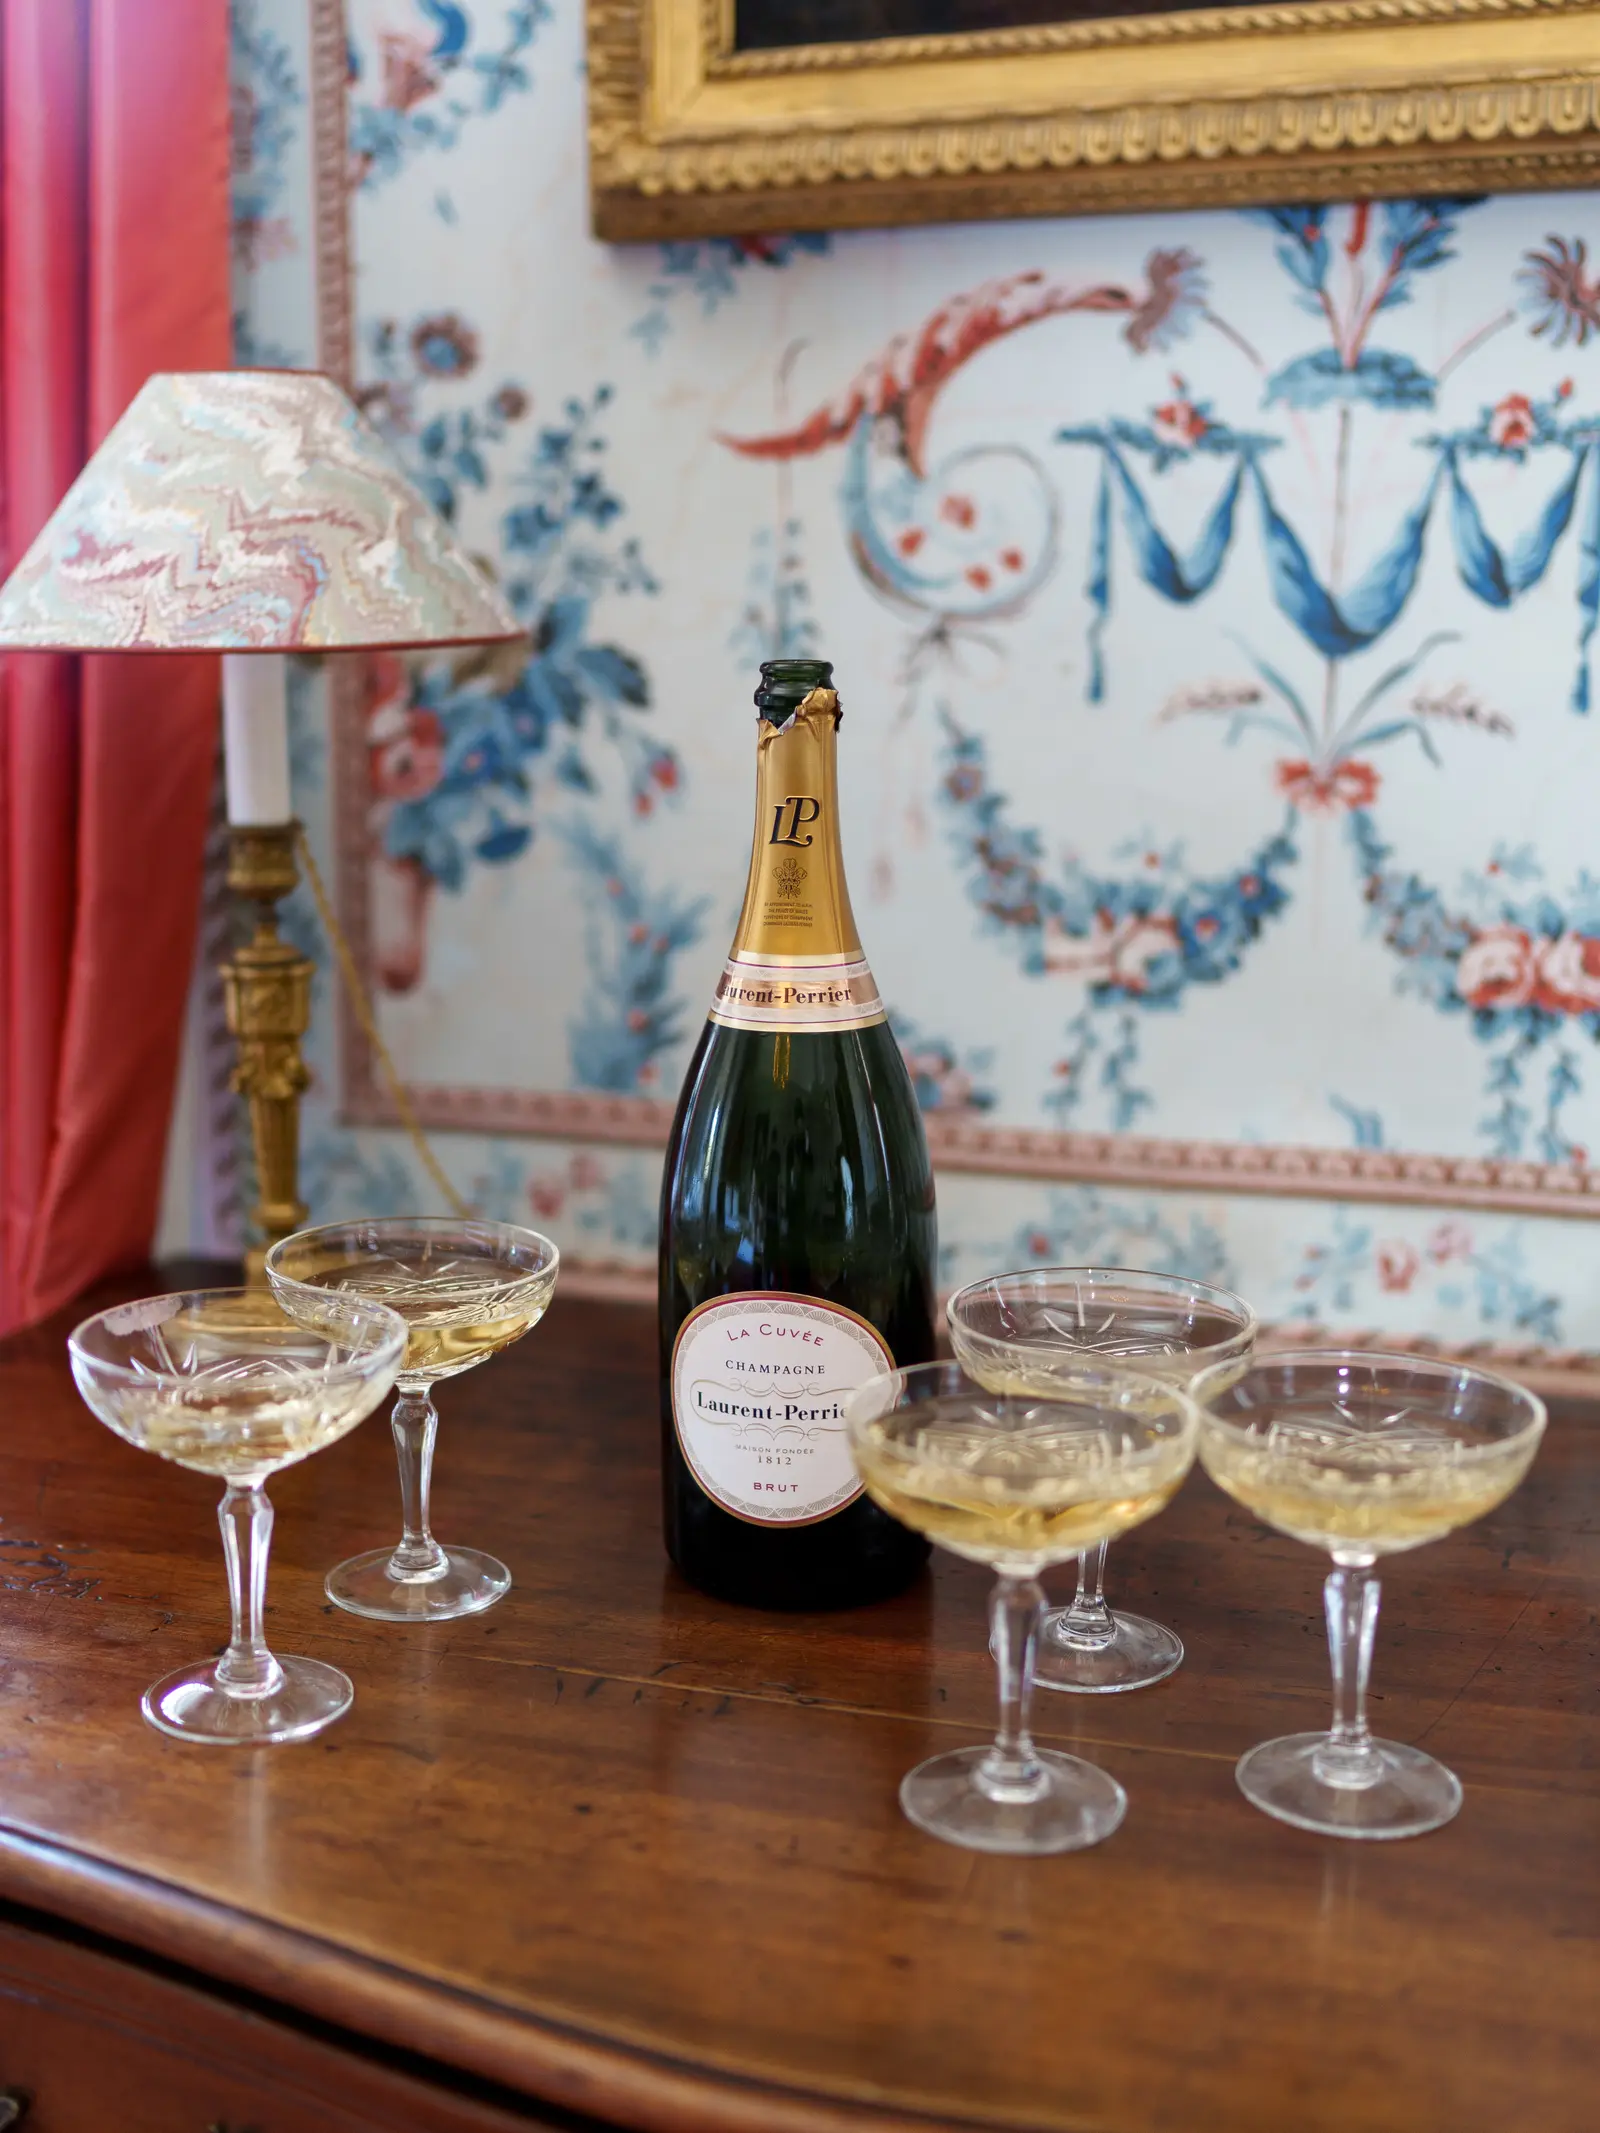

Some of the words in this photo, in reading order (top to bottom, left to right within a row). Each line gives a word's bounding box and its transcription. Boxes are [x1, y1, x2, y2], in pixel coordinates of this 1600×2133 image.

[769, 796, 820, 847] LP
[721, 986, 852, 1004] aurent-Perrier
[727, 1329, 750, 1341] LA
[759, 1323, 824, 1347] CUVÉE
[725, 1359, 826, 1375] CHAMPAGNE
[697, 1391, 848, 1421] Laurent-Perrie
[735, 1443, 771, 1454] MAISON
[757, 1455, 792, 1466] 1812
[753, 1482, 799, 1493] BRUT
